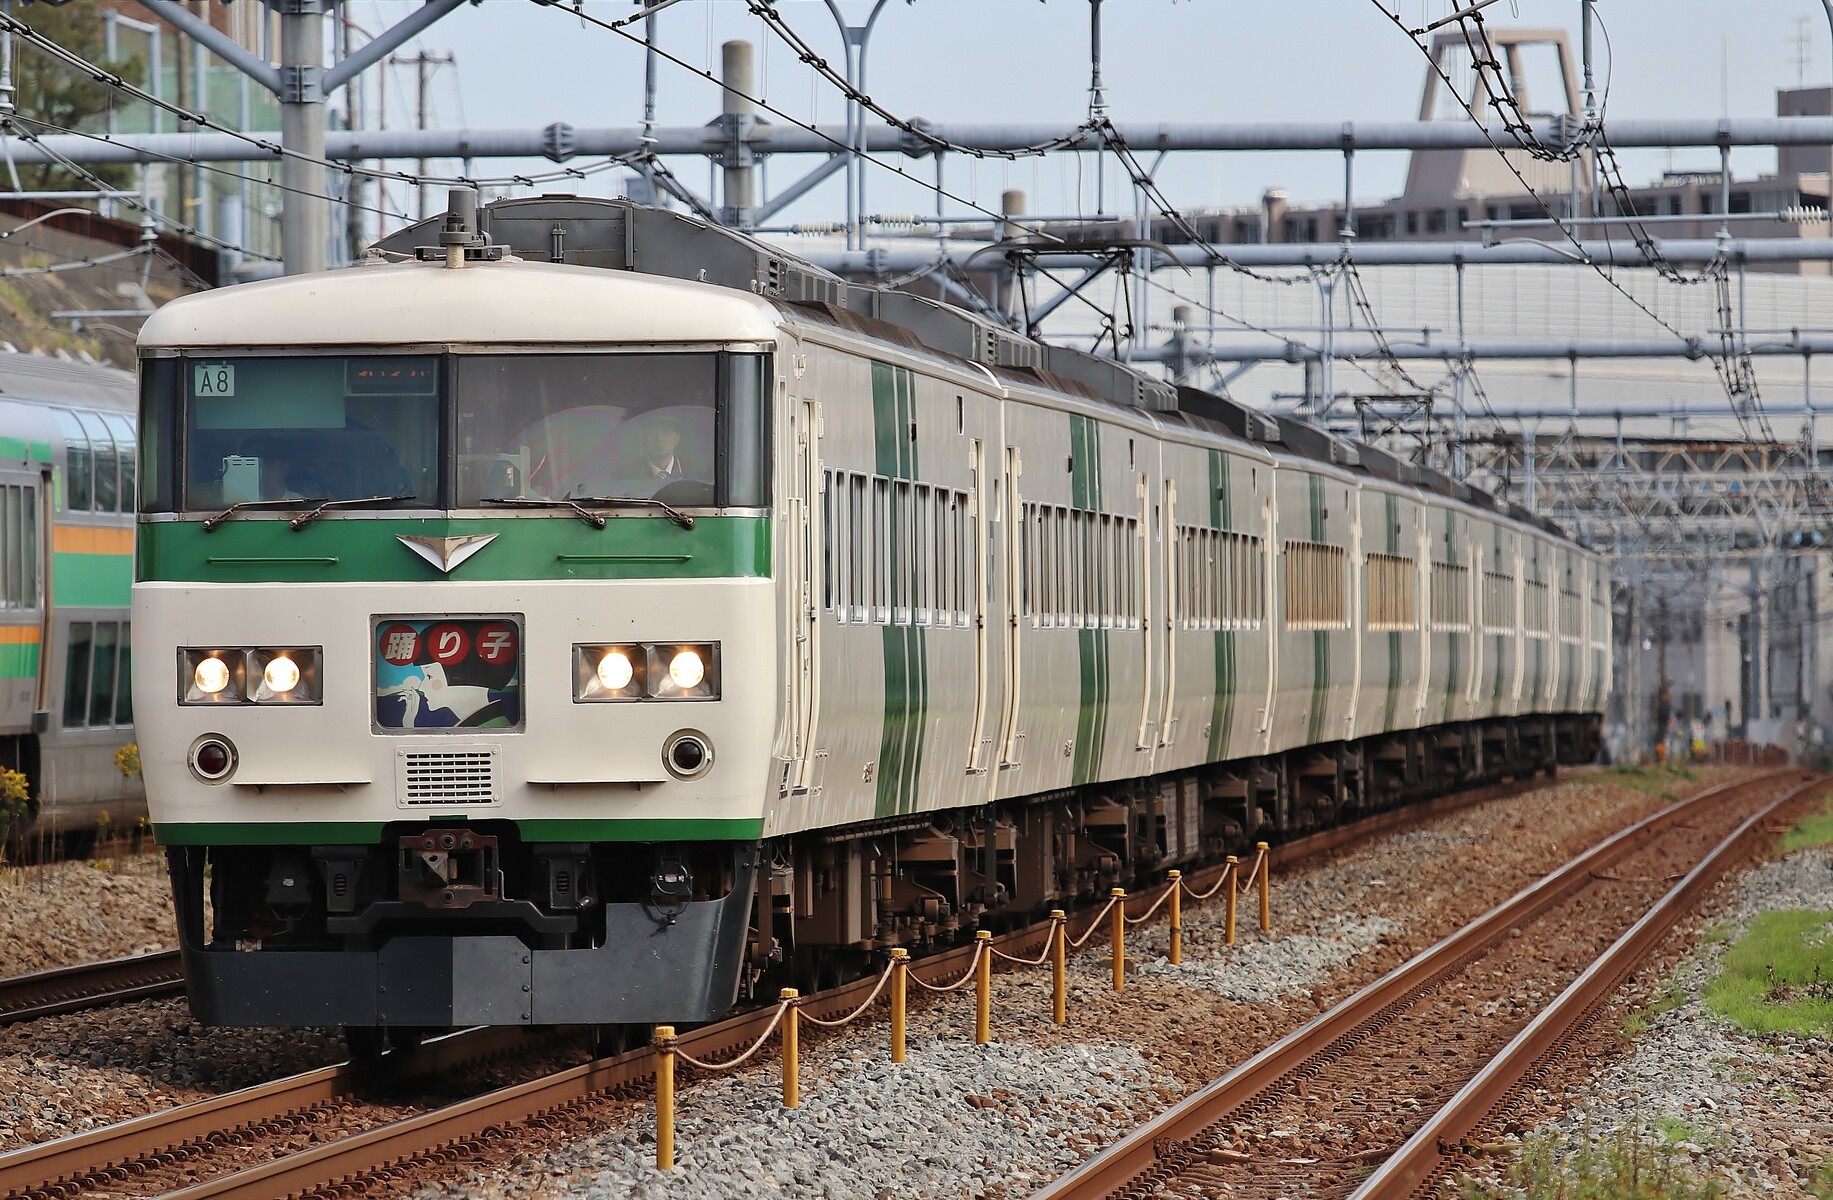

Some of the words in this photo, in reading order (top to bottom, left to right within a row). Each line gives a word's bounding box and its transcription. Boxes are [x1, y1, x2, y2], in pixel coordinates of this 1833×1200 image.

[200, 370, 229, 393] A8
[384, 631, 512, 660] 踊り子
